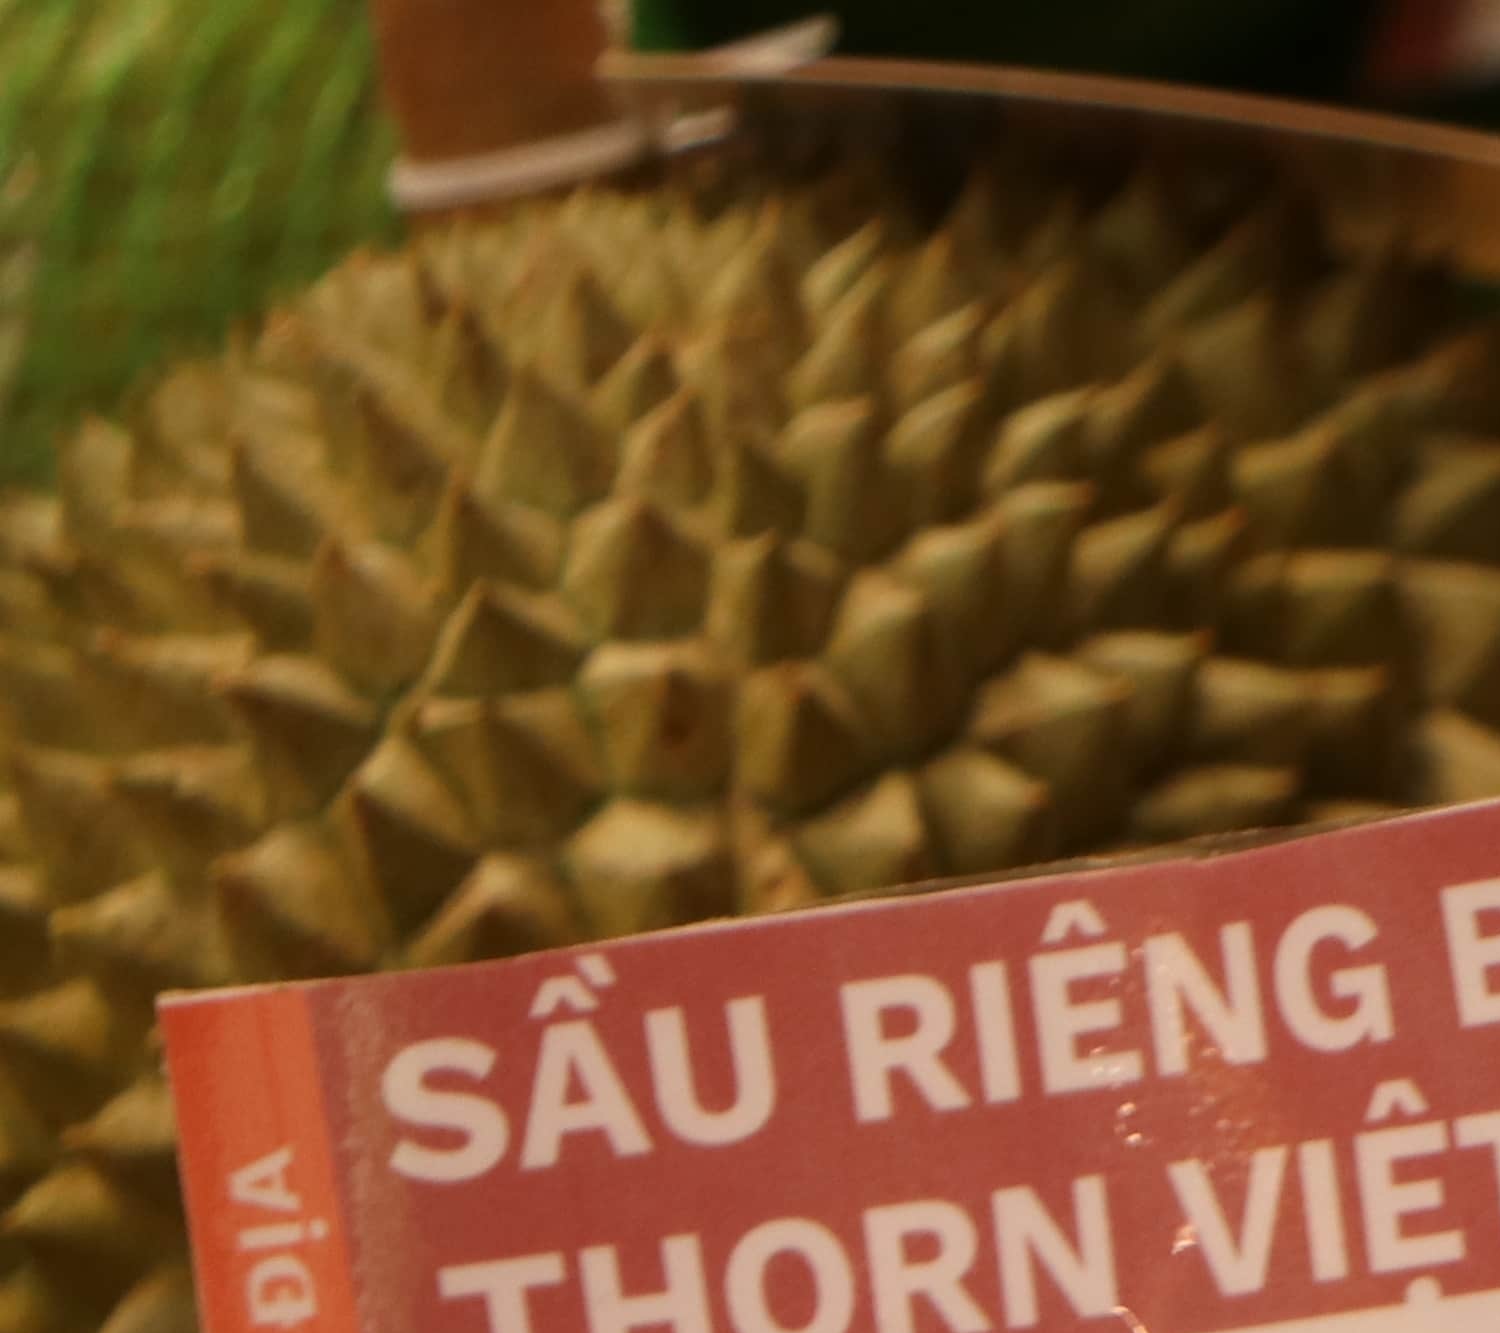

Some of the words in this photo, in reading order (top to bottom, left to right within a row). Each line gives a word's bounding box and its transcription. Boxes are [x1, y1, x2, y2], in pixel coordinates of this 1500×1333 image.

[381, 953, 777, 1186] SẦU
[840, 899, 1396, 1125] RIÊNG
[228, 1146, 329, 1328] ĐỊA
